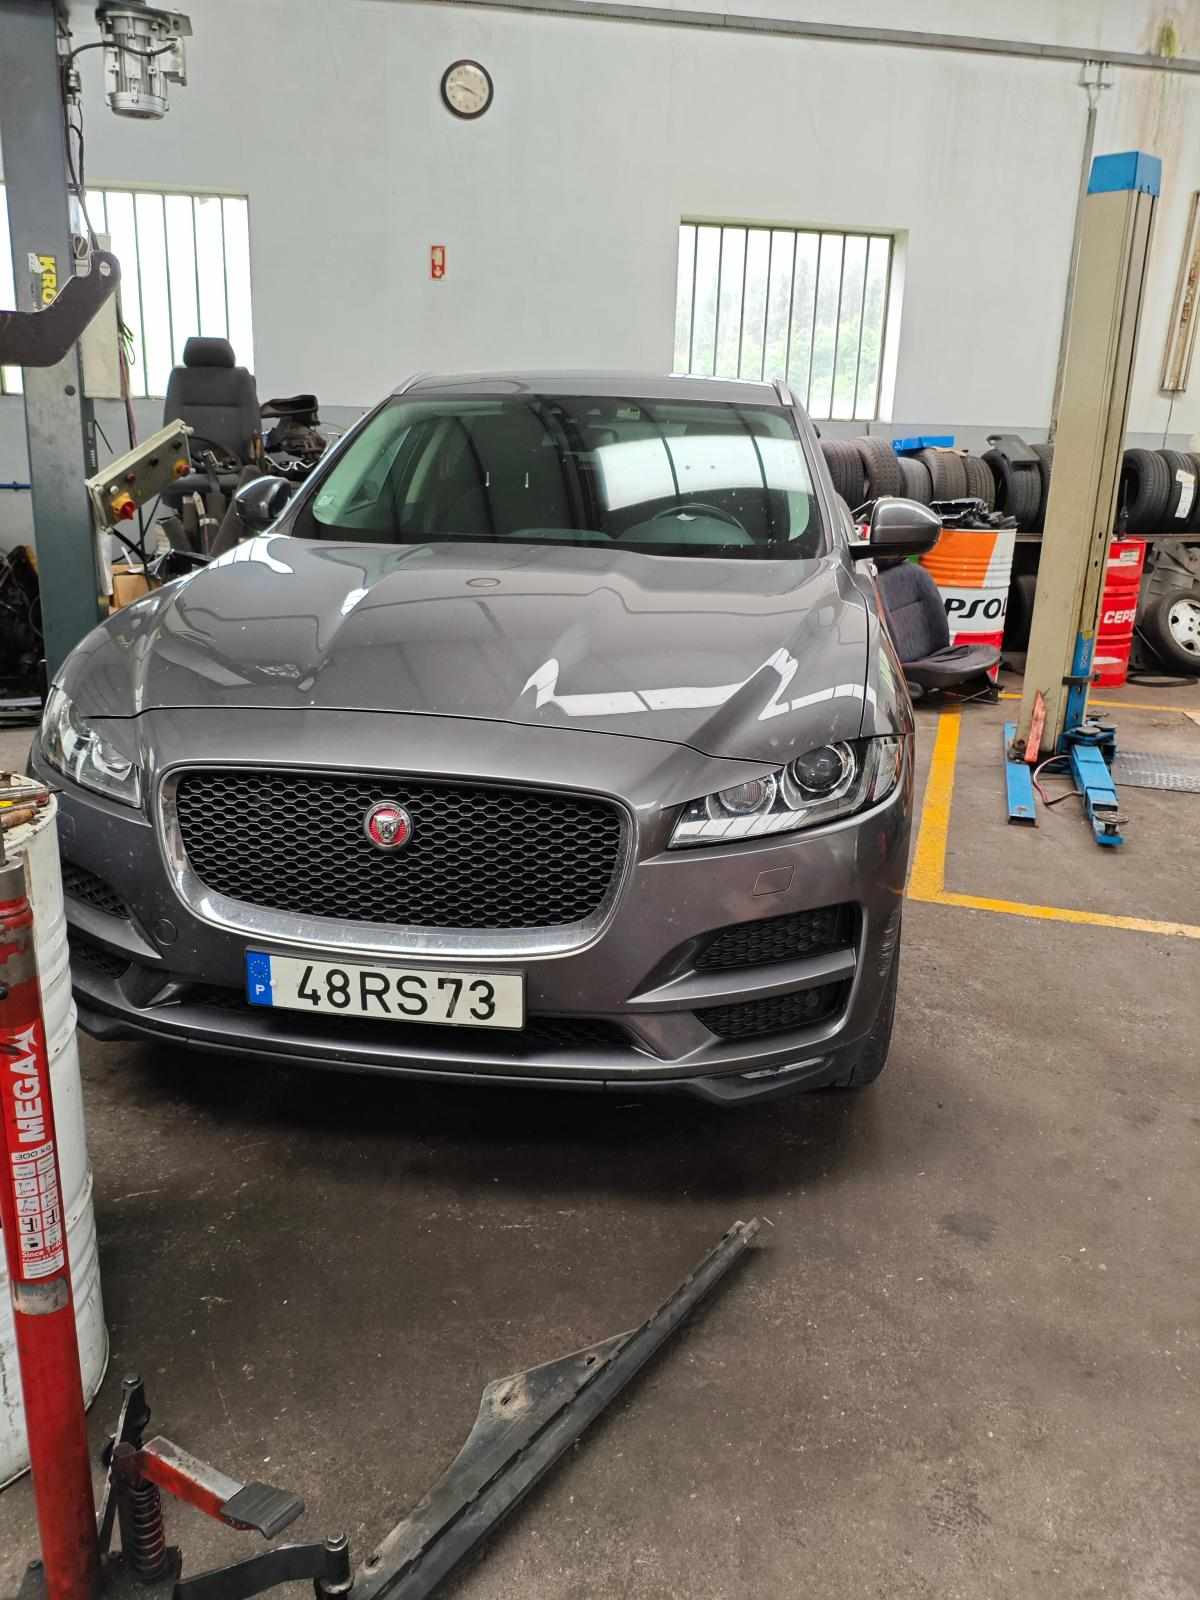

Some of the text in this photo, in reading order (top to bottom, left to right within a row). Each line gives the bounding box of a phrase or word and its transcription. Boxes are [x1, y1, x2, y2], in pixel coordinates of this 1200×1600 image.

[40, 256, 56, 304] KRO
[1103, 609, 1136, 625] CEPS
[255, 984, 265, 995] P
[10, 1054, 45, 1142] MEGA
